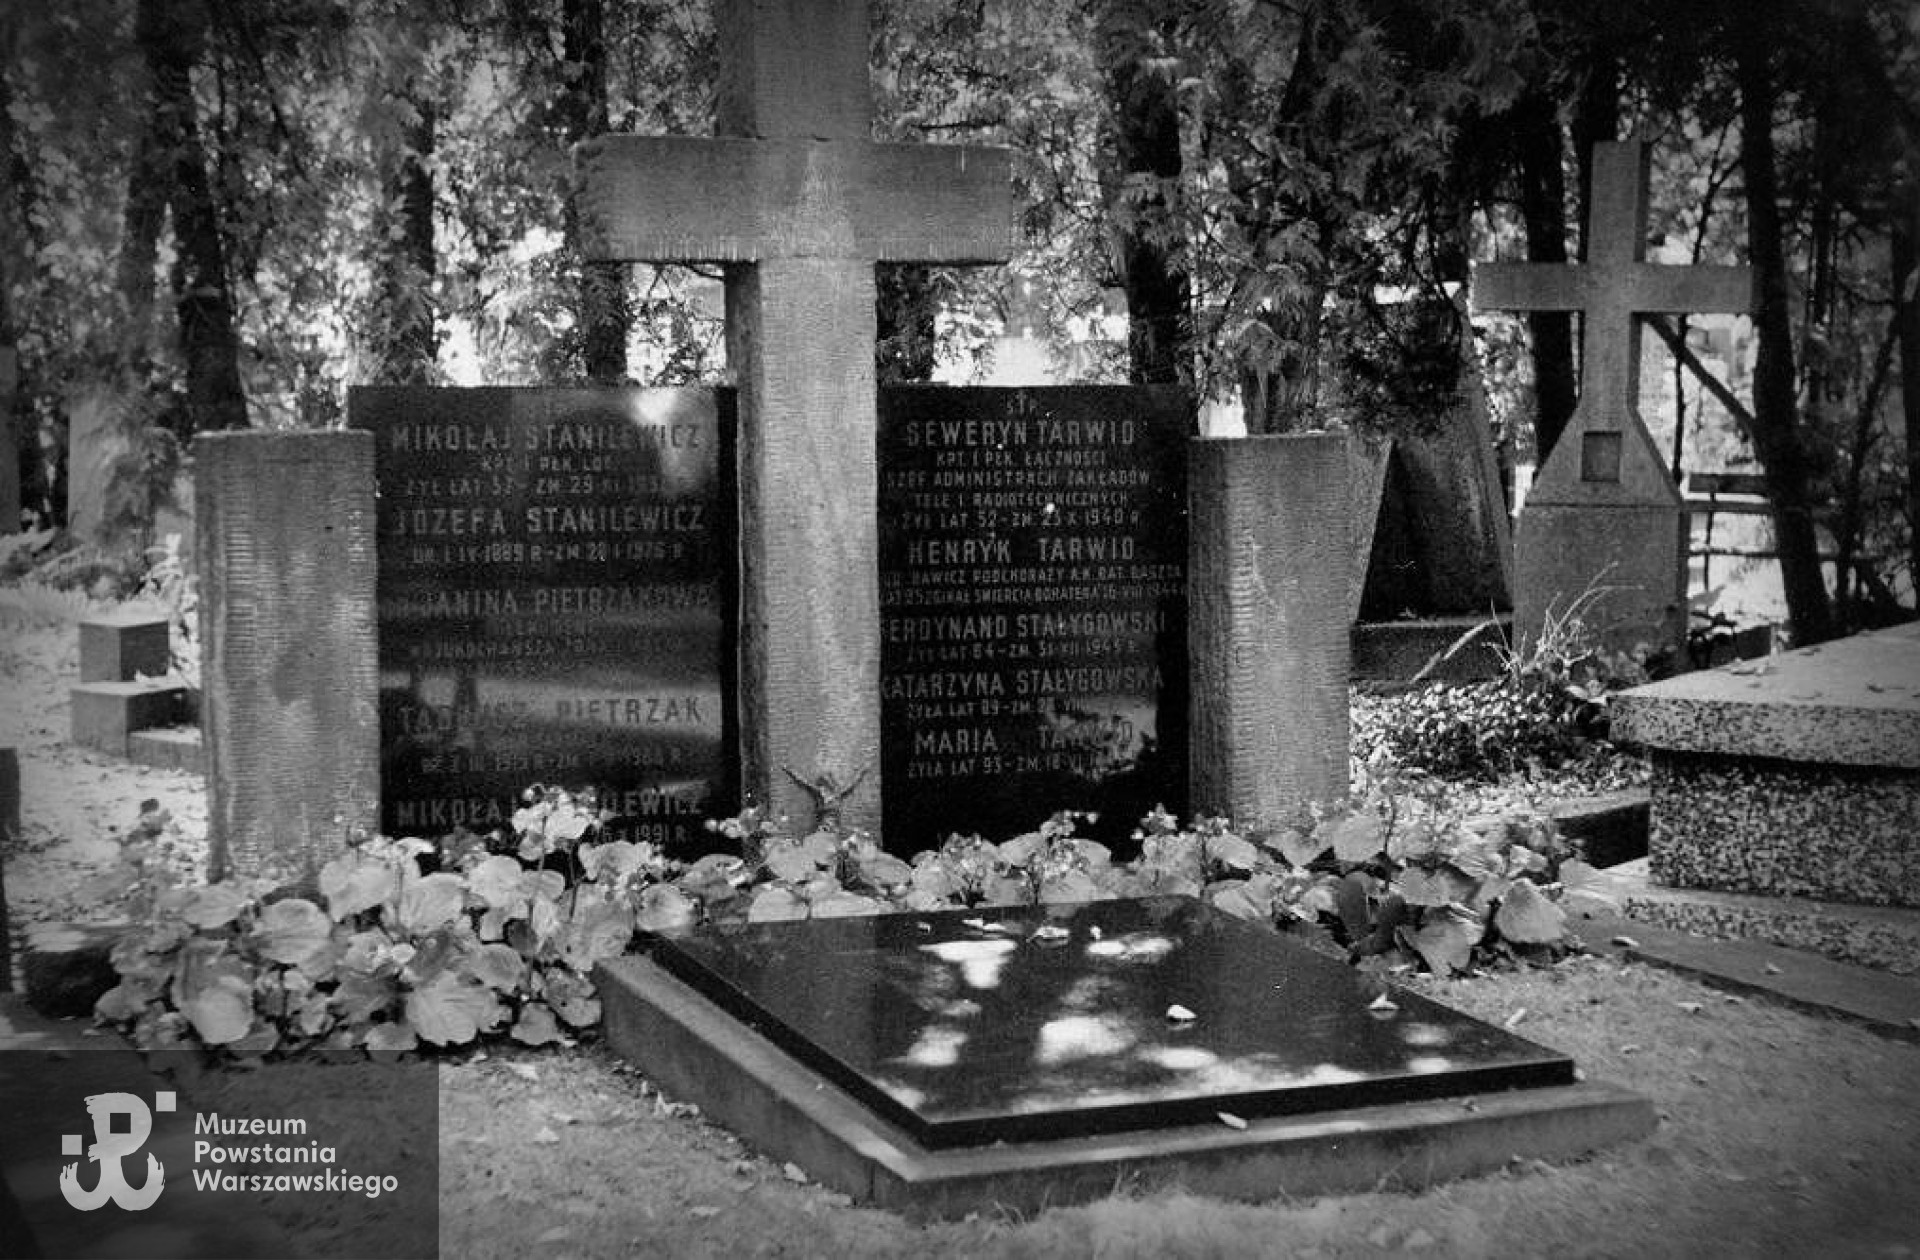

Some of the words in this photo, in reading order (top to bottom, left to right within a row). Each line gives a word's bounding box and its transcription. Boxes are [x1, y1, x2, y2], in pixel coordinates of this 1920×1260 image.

[392, 423, 511, 450] MIKOŁAJ
[526, 422, 701, 450] STANILEWICZ
[906, 420, 1027, 446] SEWERYN
[1037, 419, 1134, 445] TARWID
[933, 468, 1058, 487] ADMINISTRACJI
[526, 503, 704, 533] STANILEWICZ
[940, 512, 969, 528] LAT
[908, 539, 1012, 565] HENRYK
[1037, 536, 1135, 562] TARWID
[887, 613, 1008, 643] ERDYNAND
[1016, 610, 1165, 638] STAŁYGOWSKI
[1016, 665, 1165, 695] STAŁYGOWSKA
[555, 696, 702, 725] PIETRZAK
[949, 701, 973, 718] LAT
[915, 726, 999, 755] MARIA
[1038, 719, 1134, 751] TAD
[952, 758, 975, 776] LAT
